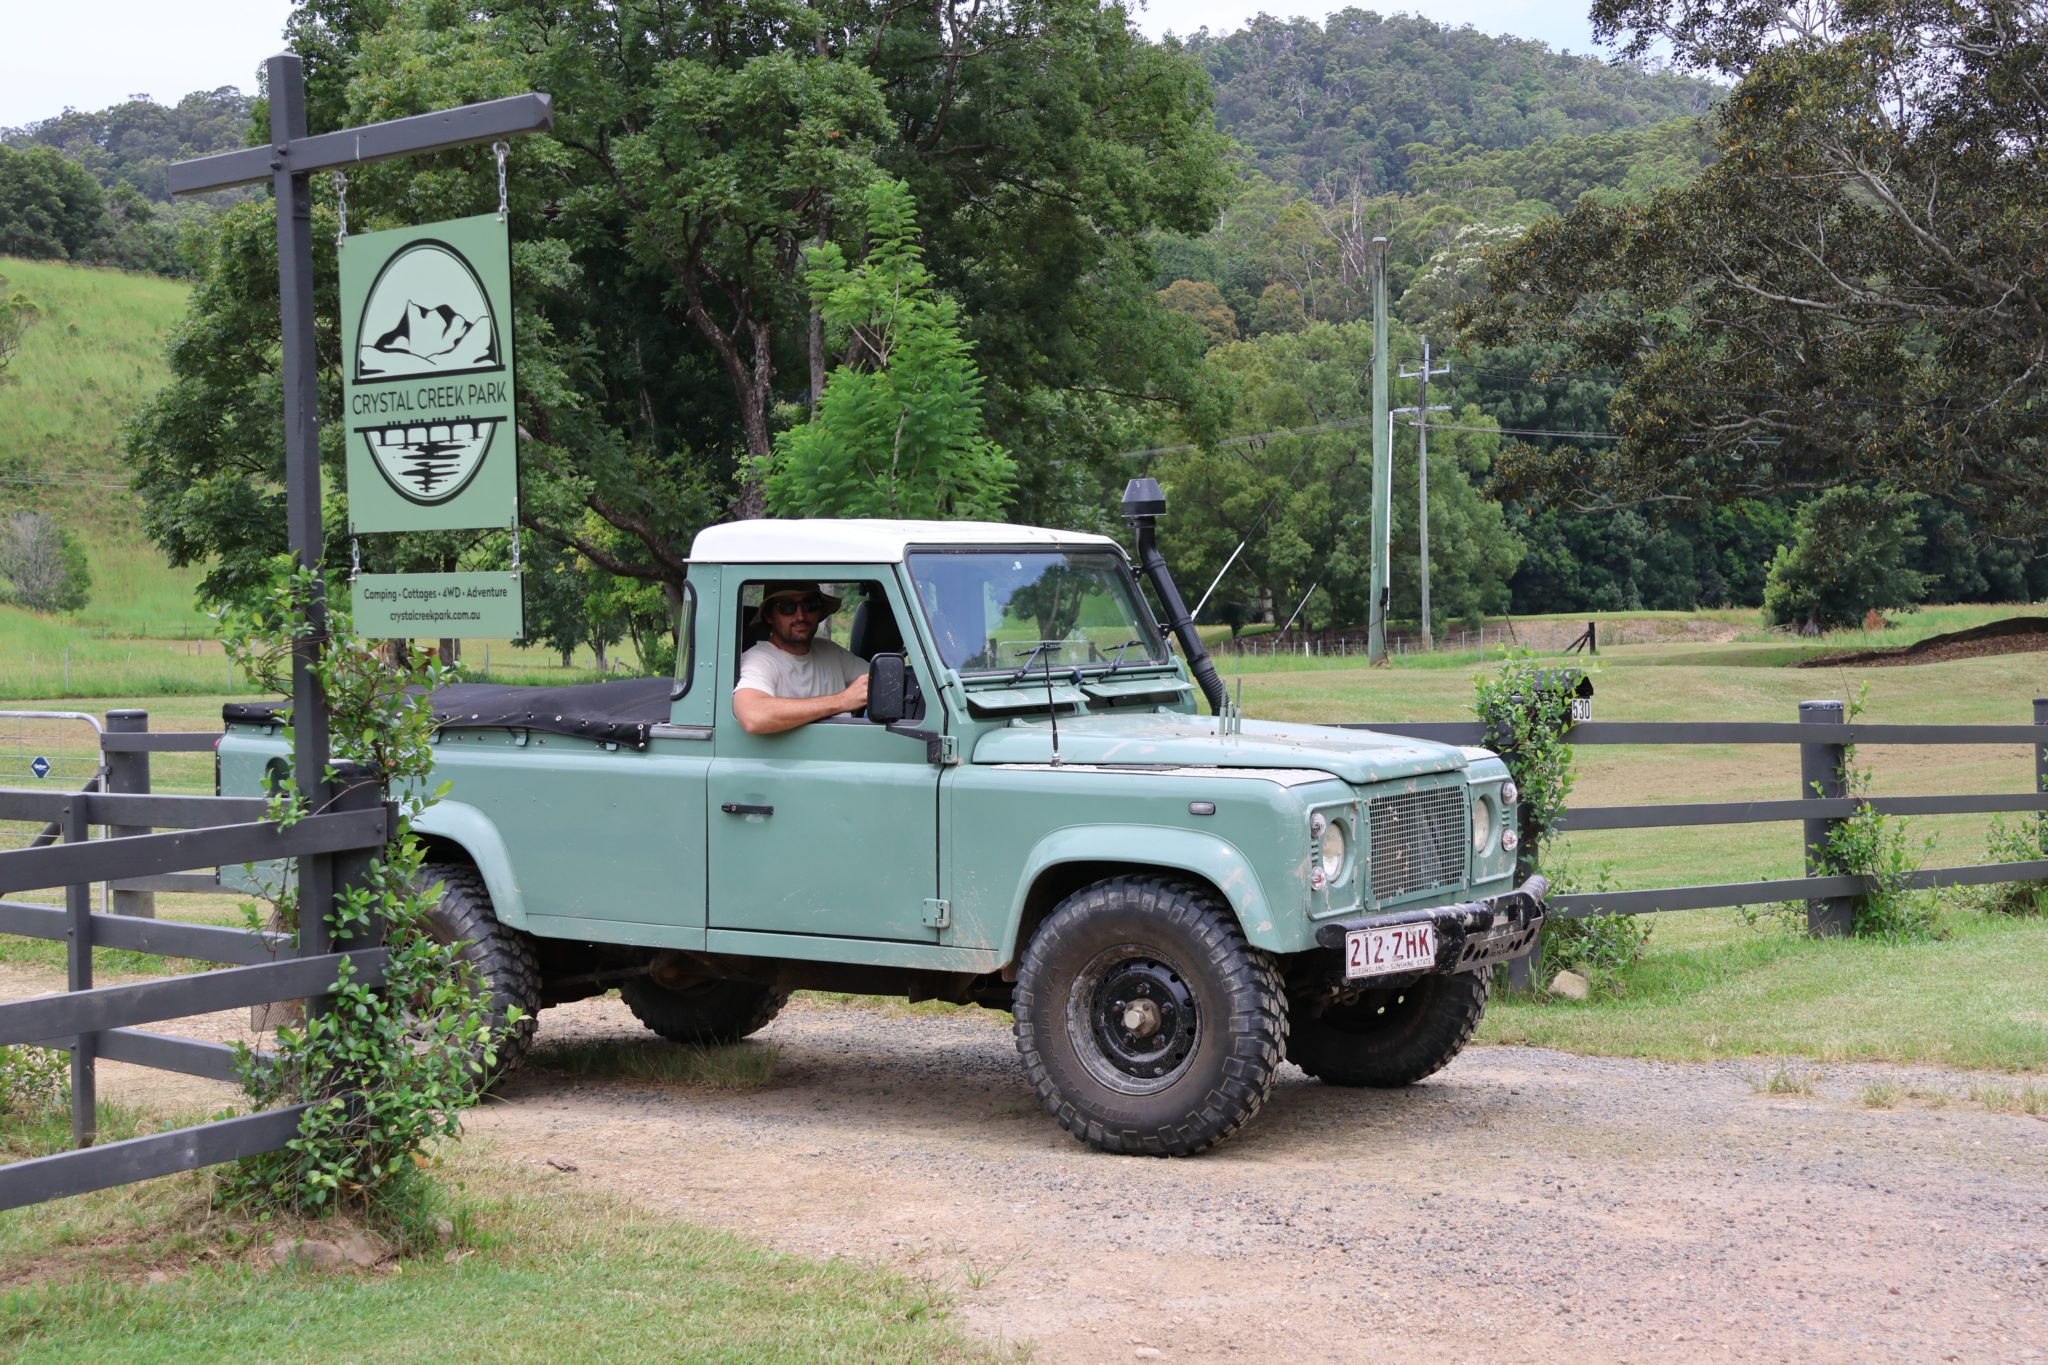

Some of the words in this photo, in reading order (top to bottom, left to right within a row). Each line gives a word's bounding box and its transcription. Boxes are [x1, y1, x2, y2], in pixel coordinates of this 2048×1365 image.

[352, 390, 415, 415] CRYSTAL
[417, 385, 466, 410] CREEK
[468, 381, 508, 406] PARK
[364, 588, 397, 602] Camping
[402, 587, 437, 602] Cottages
[442, 586, 461, 598] 4WD
[466, 586, 508, 599] Adventure
[390, 609, 481, 623] crystalcreekpark.com.au
[1572, 699, 1591, 720] 530
